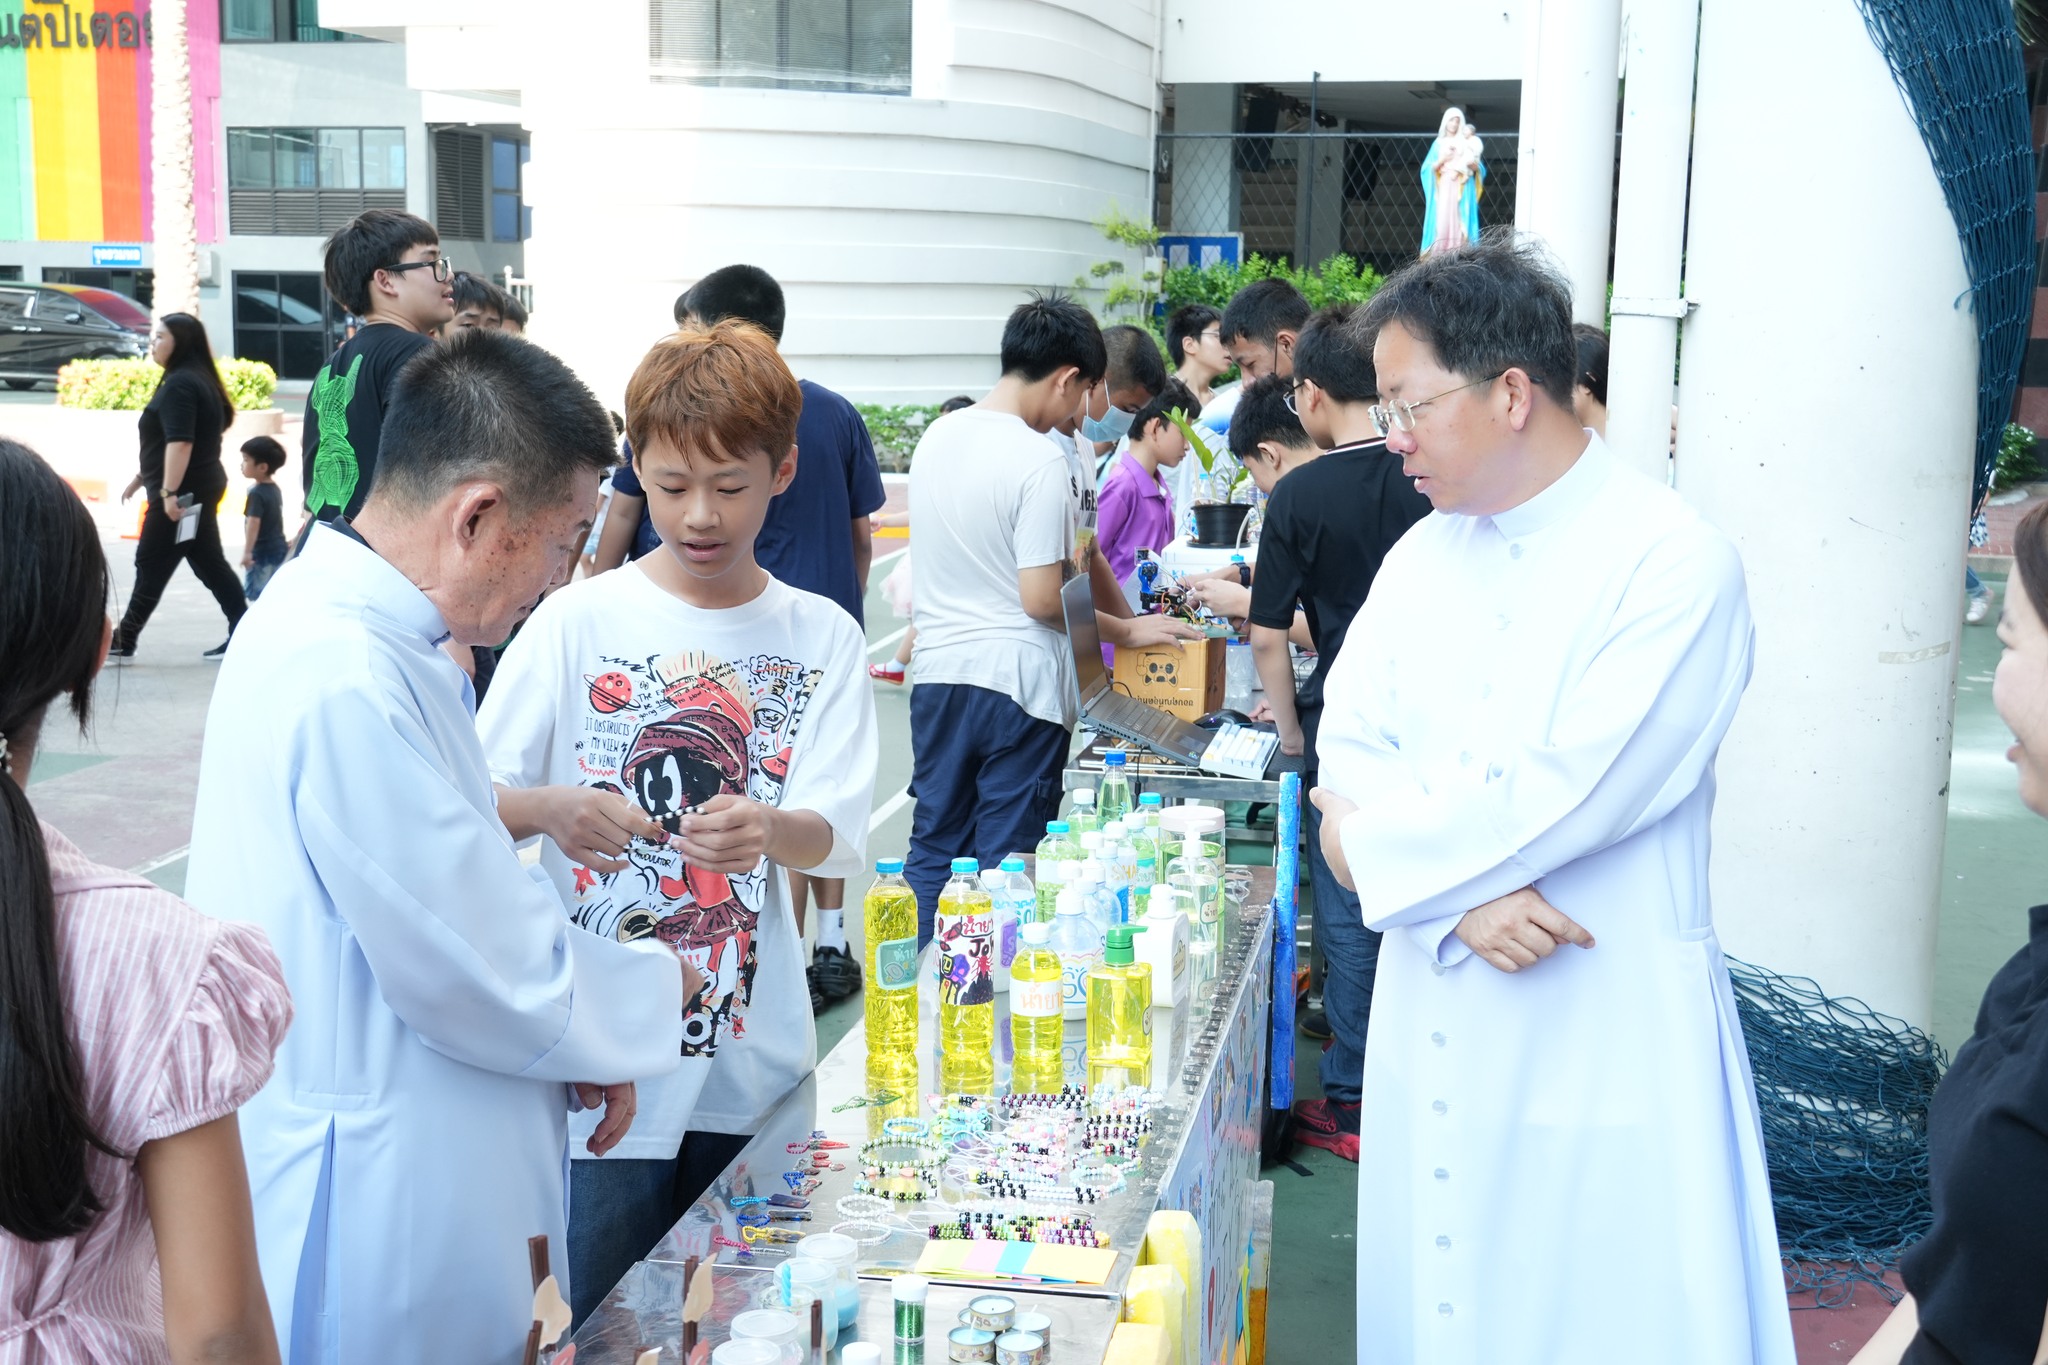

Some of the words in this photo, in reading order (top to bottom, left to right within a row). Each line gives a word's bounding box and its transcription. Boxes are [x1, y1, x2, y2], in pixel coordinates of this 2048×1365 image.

[637, 690, 652, 702] The
[638, 709, 658, 721] going
[594, 719, 631, 736] OBSTRUCTS
[591, 736, 601, 749] MY
[602, 738, 620, 752] VIEW
[589, 753, 597, 765] OF
[598, 754, 617, 768] VENUS
